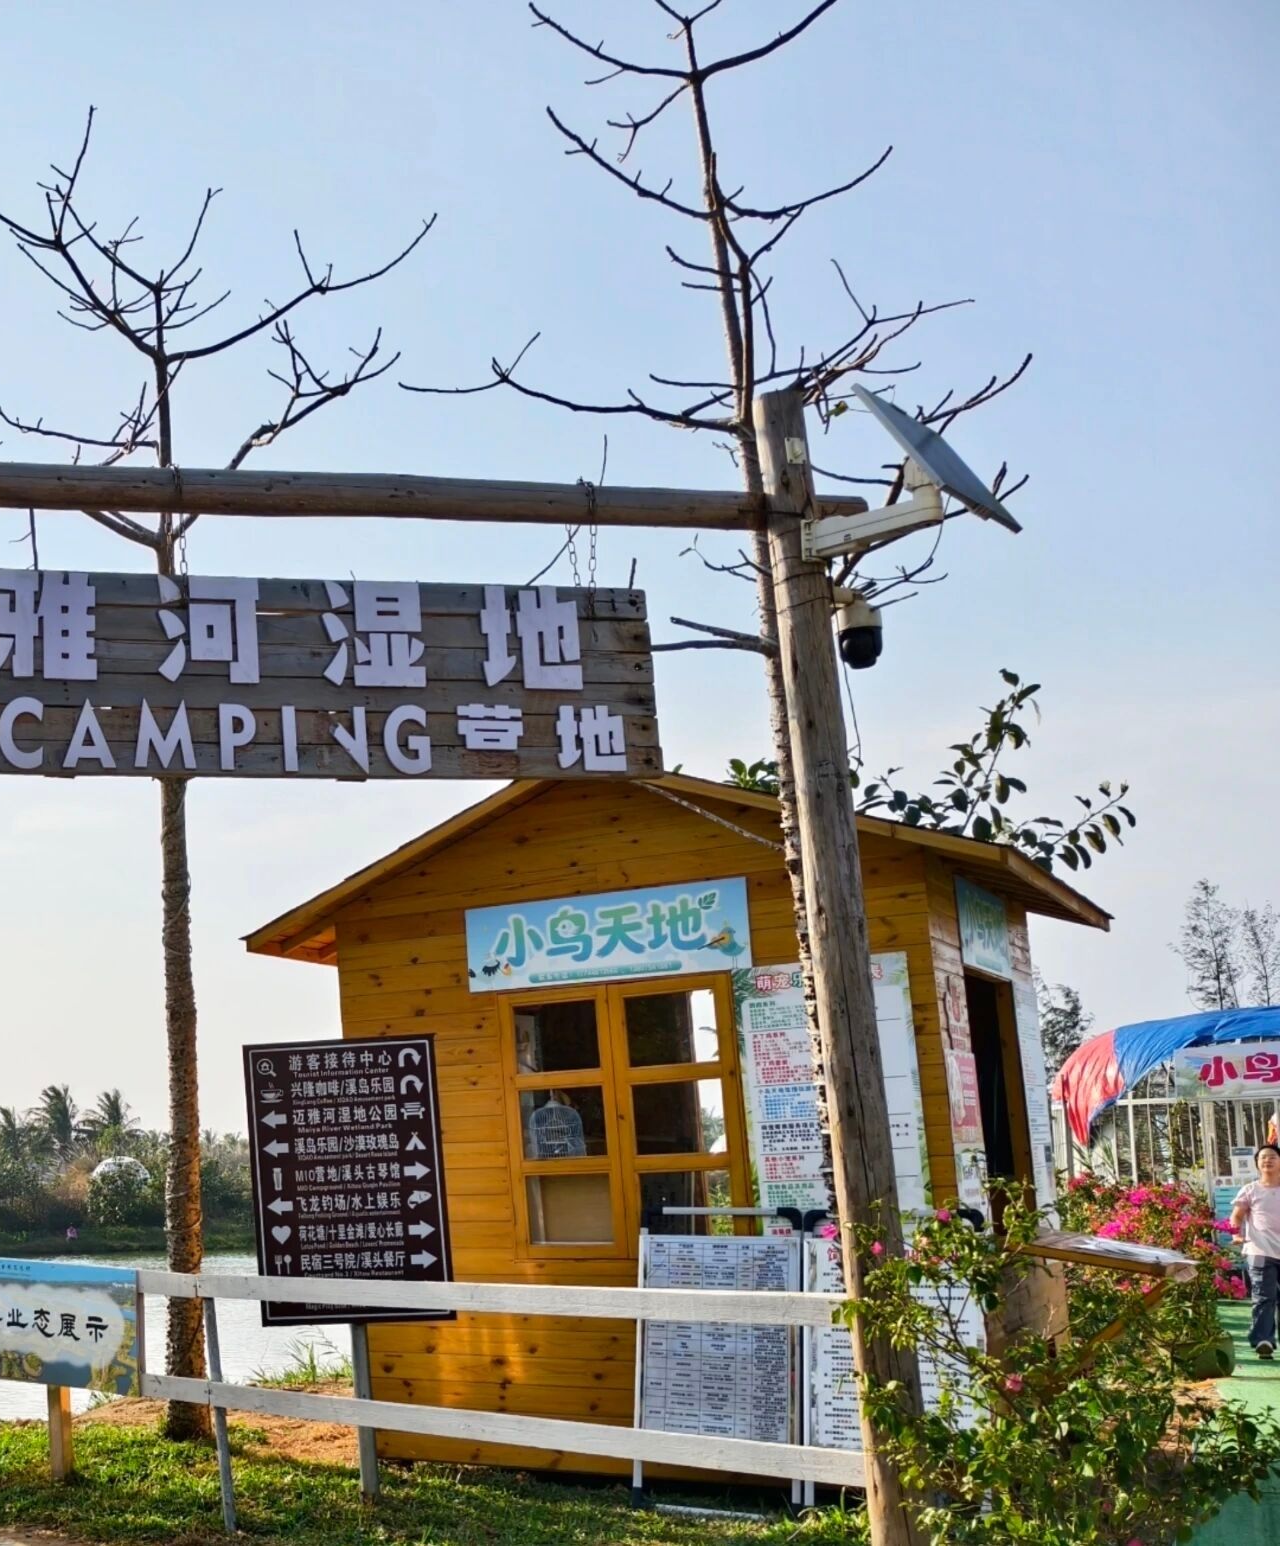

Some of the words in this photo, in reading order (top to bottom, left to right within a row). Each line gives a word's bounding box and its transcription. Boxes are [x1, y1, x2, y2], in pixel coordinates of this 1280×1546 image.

[494, 897, 708, 968] 小鸟天地
[288, 1050, 392, 1071] 游客接待中心
[1199, 1053, 1280, 1088] 小鸟
[320, 1069, 363, 1077] Information
[290, 1076, 395, 1098] 兴隆咖啡/溪岛乐园
[292, 1104, 398, 1125] 迈雅河湿地公园
[343, 1123, 375, 1131] Wetland
[294, 1132, 399, 1154] 溪岛乐园/沙漠玫瑰岛
[296, 1191, 401, 1211] 飞龙钓场/水上娱乐
[300, 1251, 406, 1271] 民宿三号院/溪头餐厅
